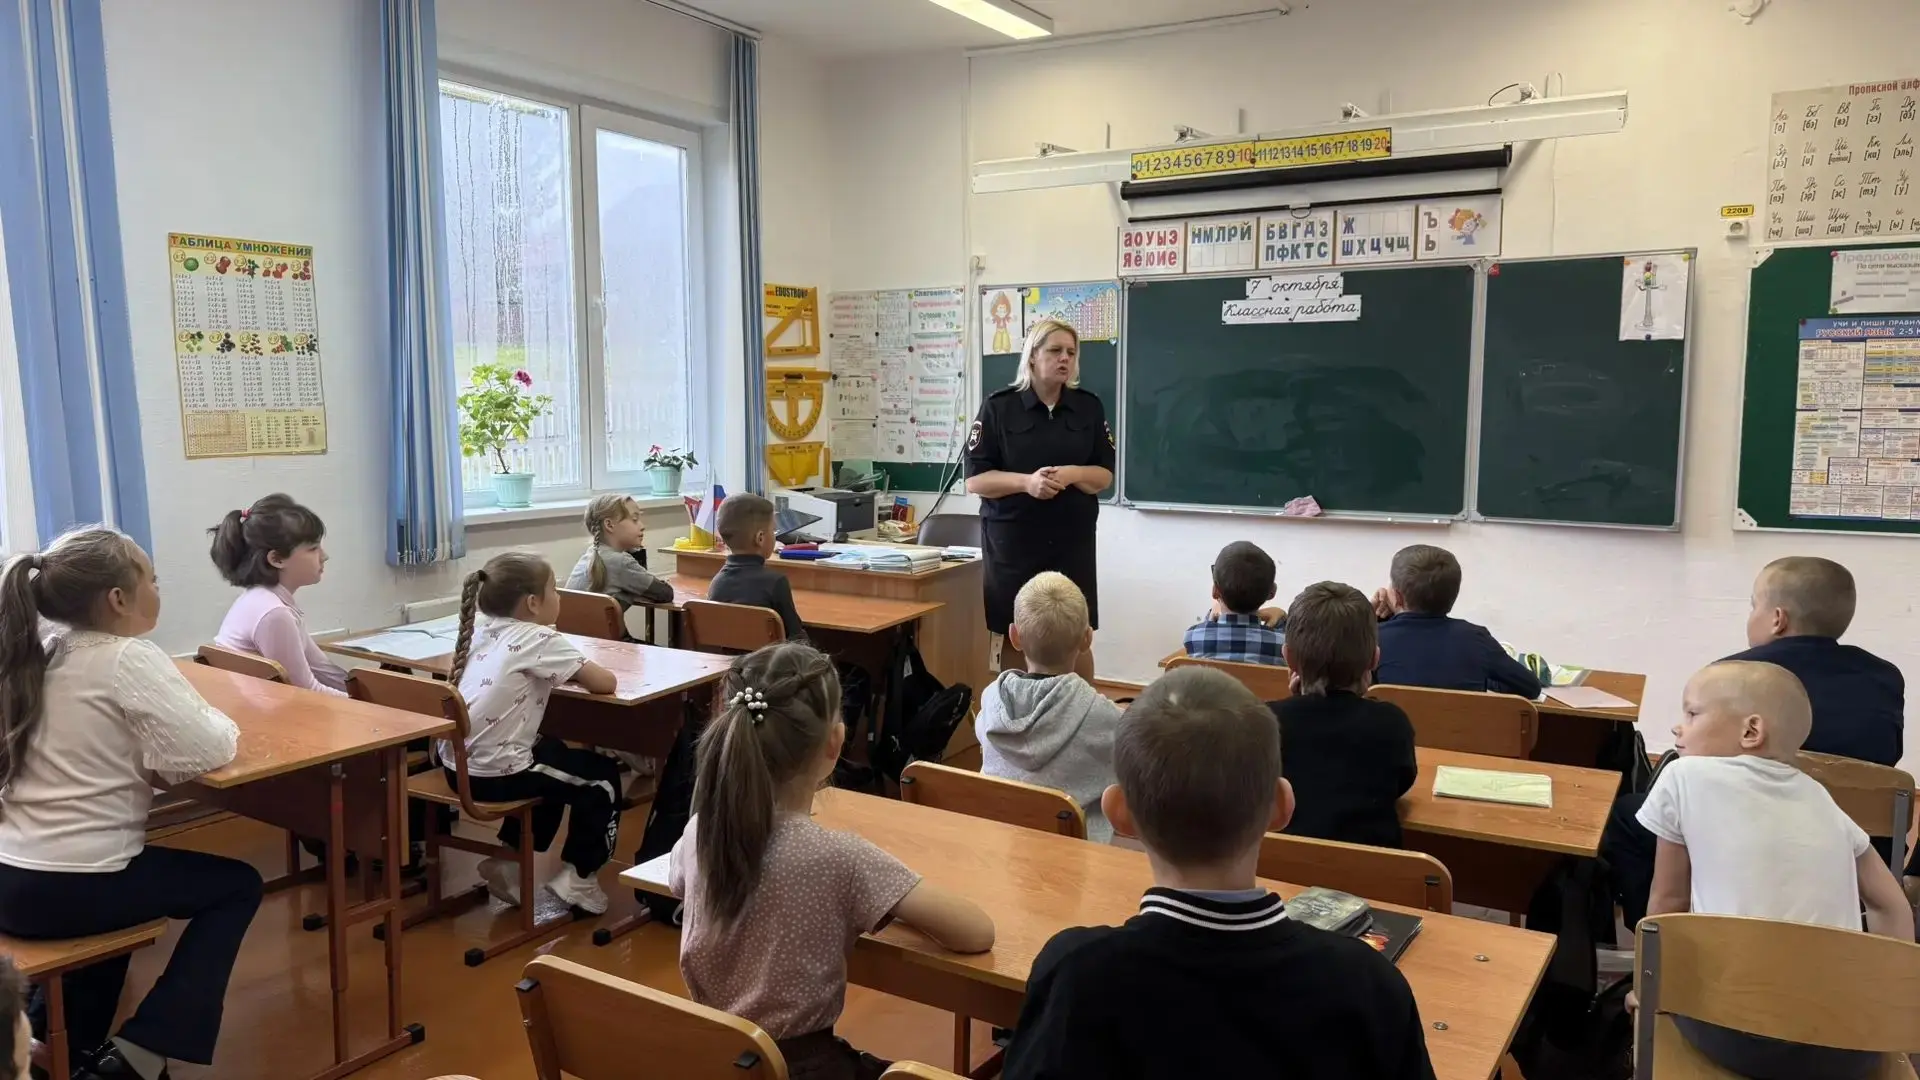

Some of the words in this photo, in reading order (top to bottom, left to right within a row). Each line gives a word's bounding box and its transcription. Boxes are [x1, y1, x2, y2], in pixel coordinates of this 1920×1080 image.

[1848, 80, 1898, 96] Прописной
[170, 236, 232, 250] ТАБЛИЦА
[236, 242, 312, 257] УМНОЖЕНИЯ
[1250, 280, 1262, 294] 7
[1224, 304, 1290, 316] Классная
[1899, 328, 1914, 336] 2-5
